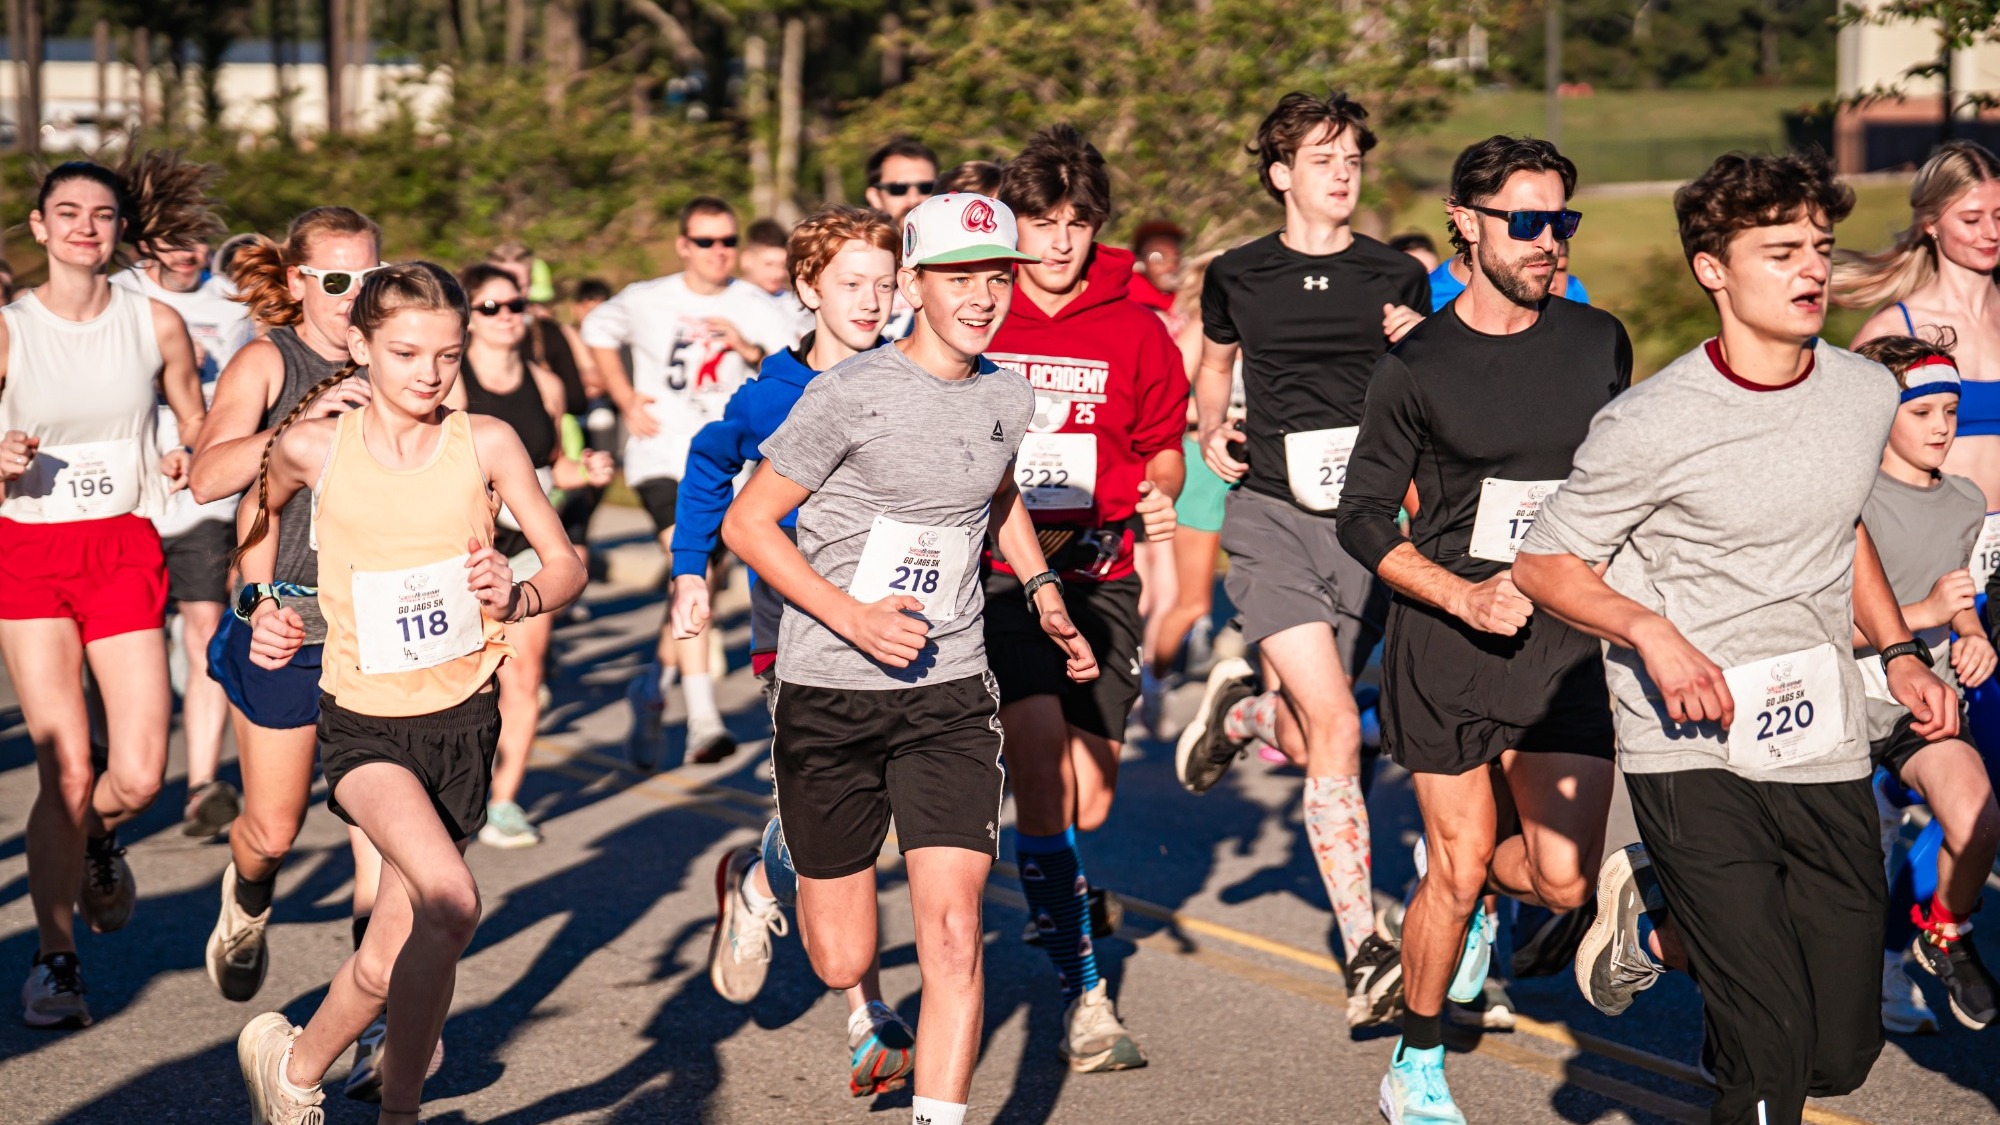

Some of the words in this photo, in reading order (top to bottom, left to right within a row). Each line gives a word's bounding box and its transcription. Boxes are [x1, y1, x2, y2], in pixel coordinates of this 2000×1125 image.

[1029, 363, 1108, 393] ACADEMY
[1075, 403, 1095, 424] 25
[1020, 468, 1069, 489] 222
[1319, 464, 1347, 485] 22
[68, 475, 114, 498] 196
[914, 558, 930, 566] JAGS
[889, 565, 940, 594] 218
[398, 605, 409, 615] GO
[411, 601, 432, 613] JAGS
[396, 610, 449, 642] 118
[1766, 697, 1776, 707] GO
[1776, 692, 1795, 705] JAGS
[1756, 699, 1815, 741] 220
